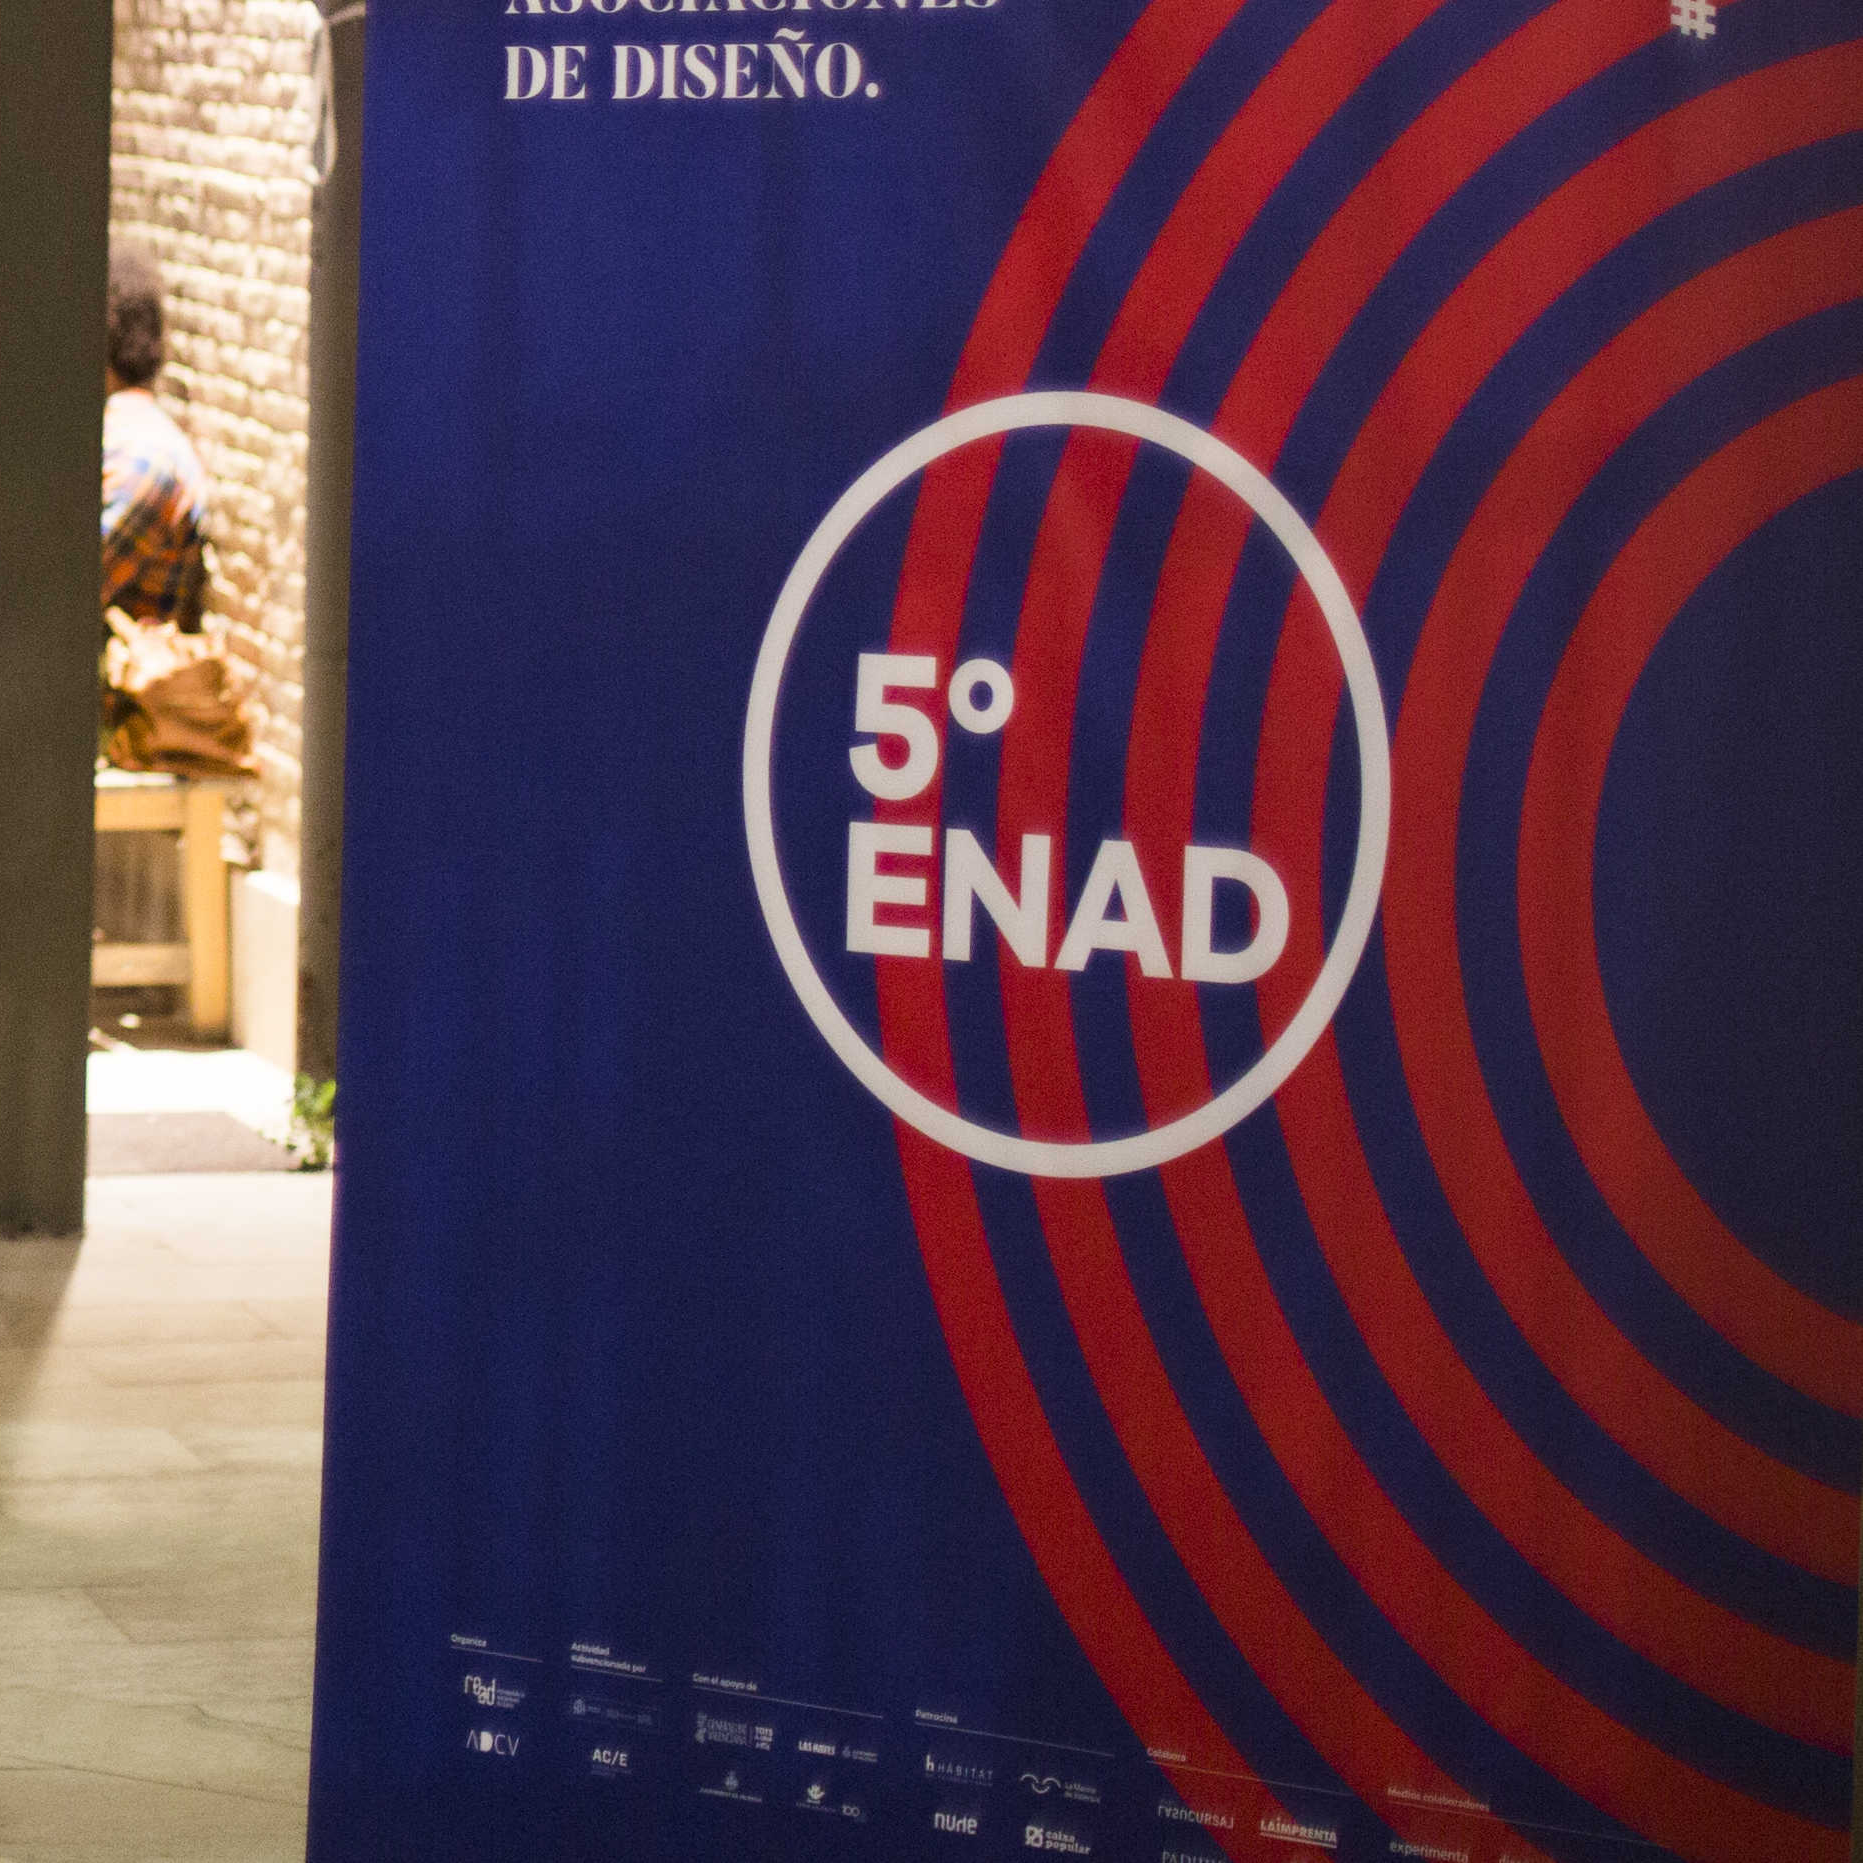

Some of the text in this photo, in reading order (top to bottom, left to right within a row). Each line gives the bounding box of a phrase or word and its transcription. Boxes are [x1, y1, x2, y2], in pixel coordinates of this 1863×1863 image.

[503, 27, 880, 100] DE DISEÑO.
[846, 821, 1290, 985] ENAD
[592, 1748, 628, 1767] AC/E
[1389, 1839, 1470, 1863] experimenta
